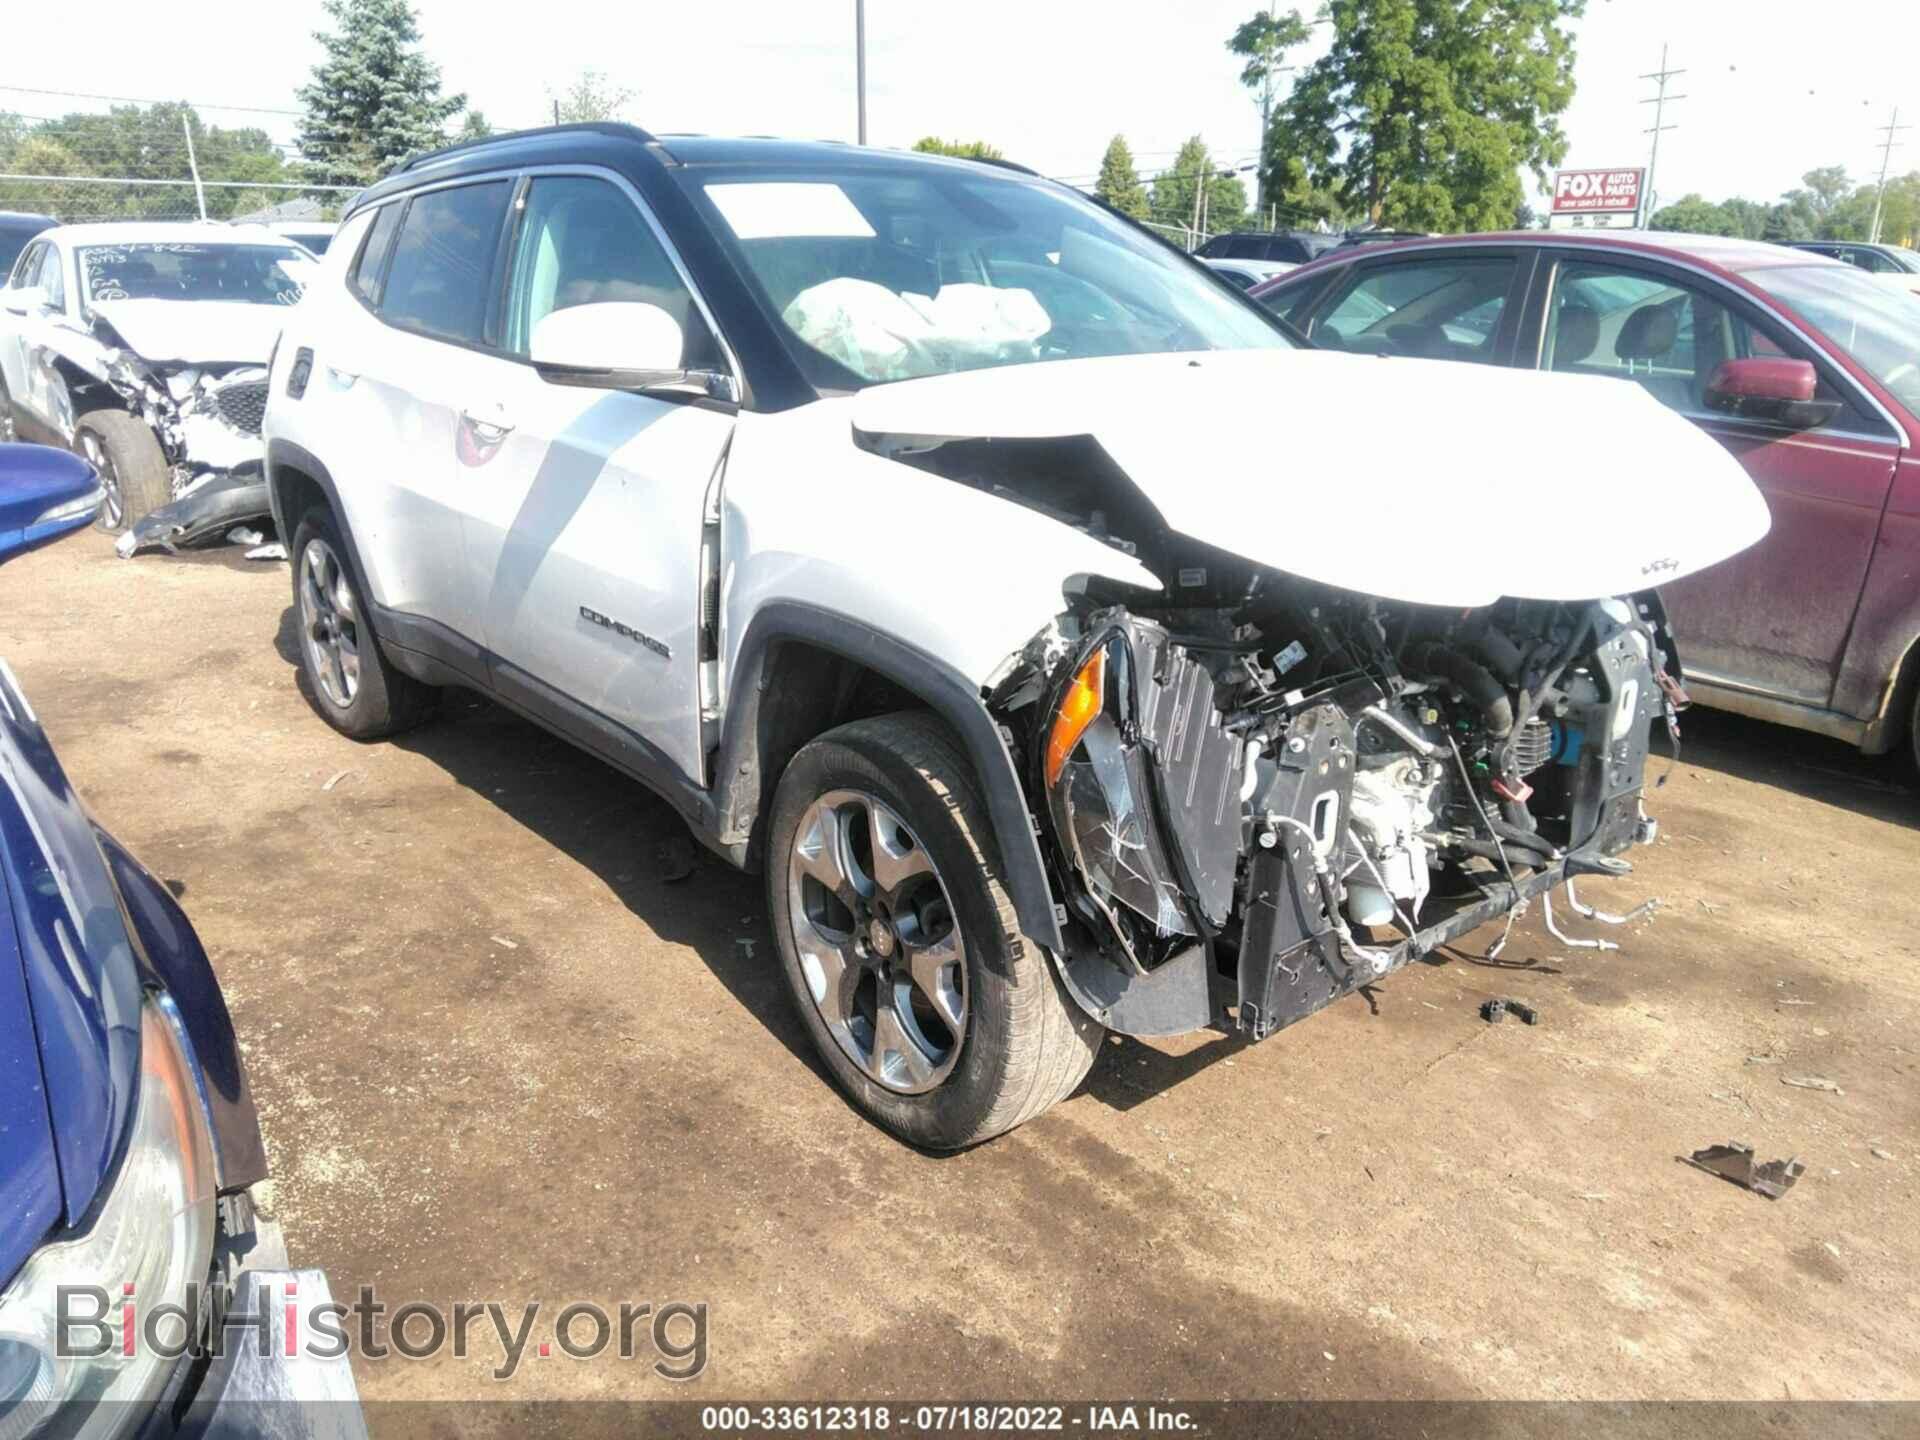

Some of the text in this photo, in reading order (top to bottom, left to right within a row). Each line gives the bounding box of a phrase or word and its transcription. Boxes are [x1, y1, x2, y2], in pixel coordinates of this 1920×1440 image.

[1606, 173, 1635, 184] AUTO
[1557, 173, 1606, 198] FOX
[1605, 184, 1637, 196] PARTS
